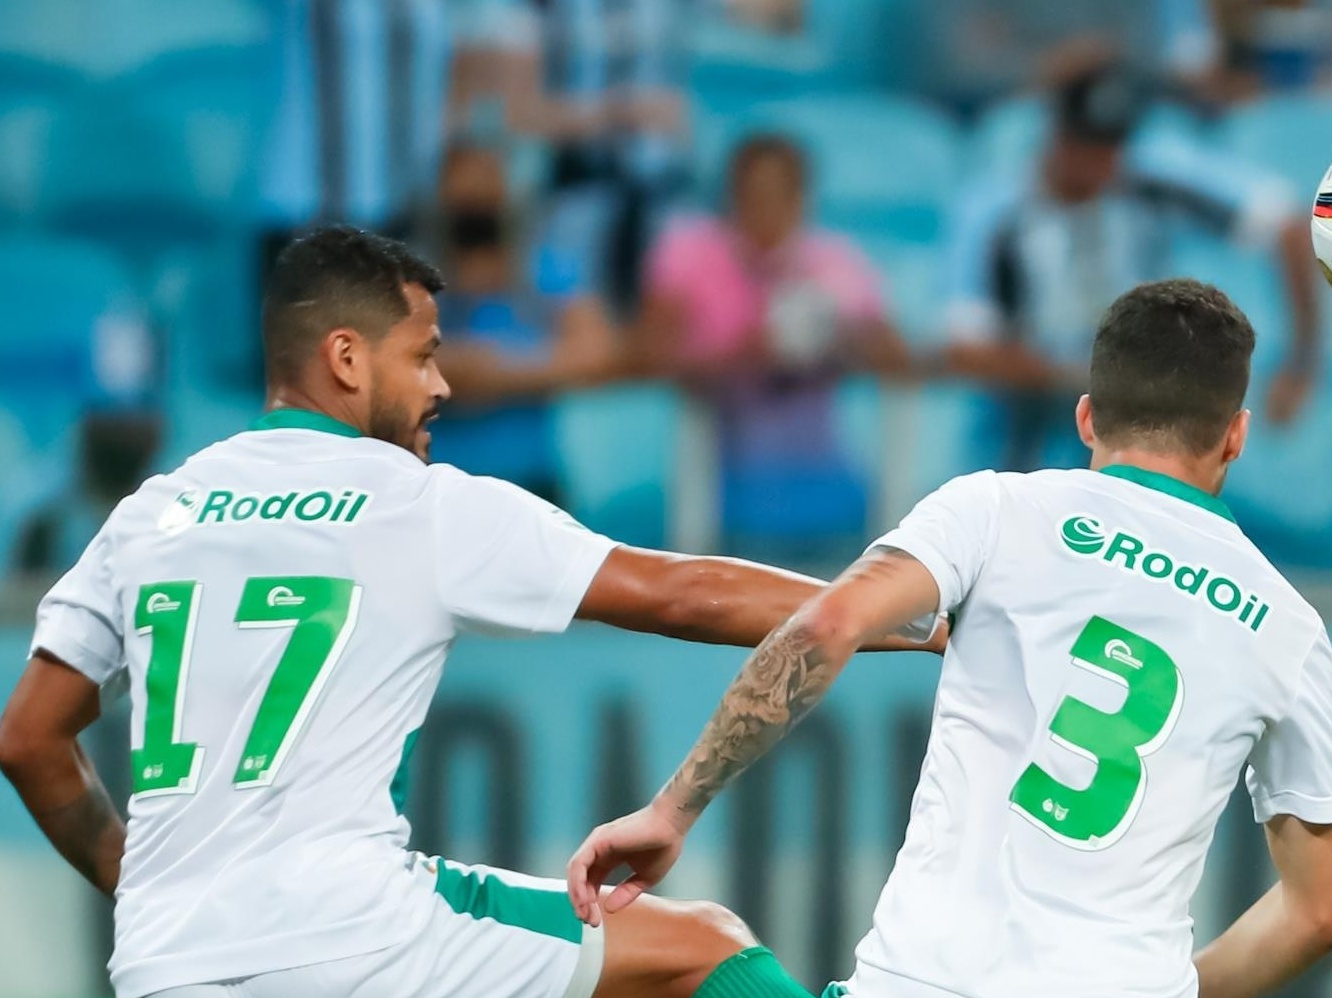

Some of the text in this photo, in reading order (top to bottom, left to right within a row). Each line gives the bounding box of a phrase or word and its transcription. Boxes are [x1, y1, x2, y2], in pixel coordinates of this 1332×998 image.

[196, 490, 369, 523] RodOil
[1103, 531, 1270, 632] RodOil
[131, 575, 361, 798] 17
[1009, 614, 1184, 850] 3
